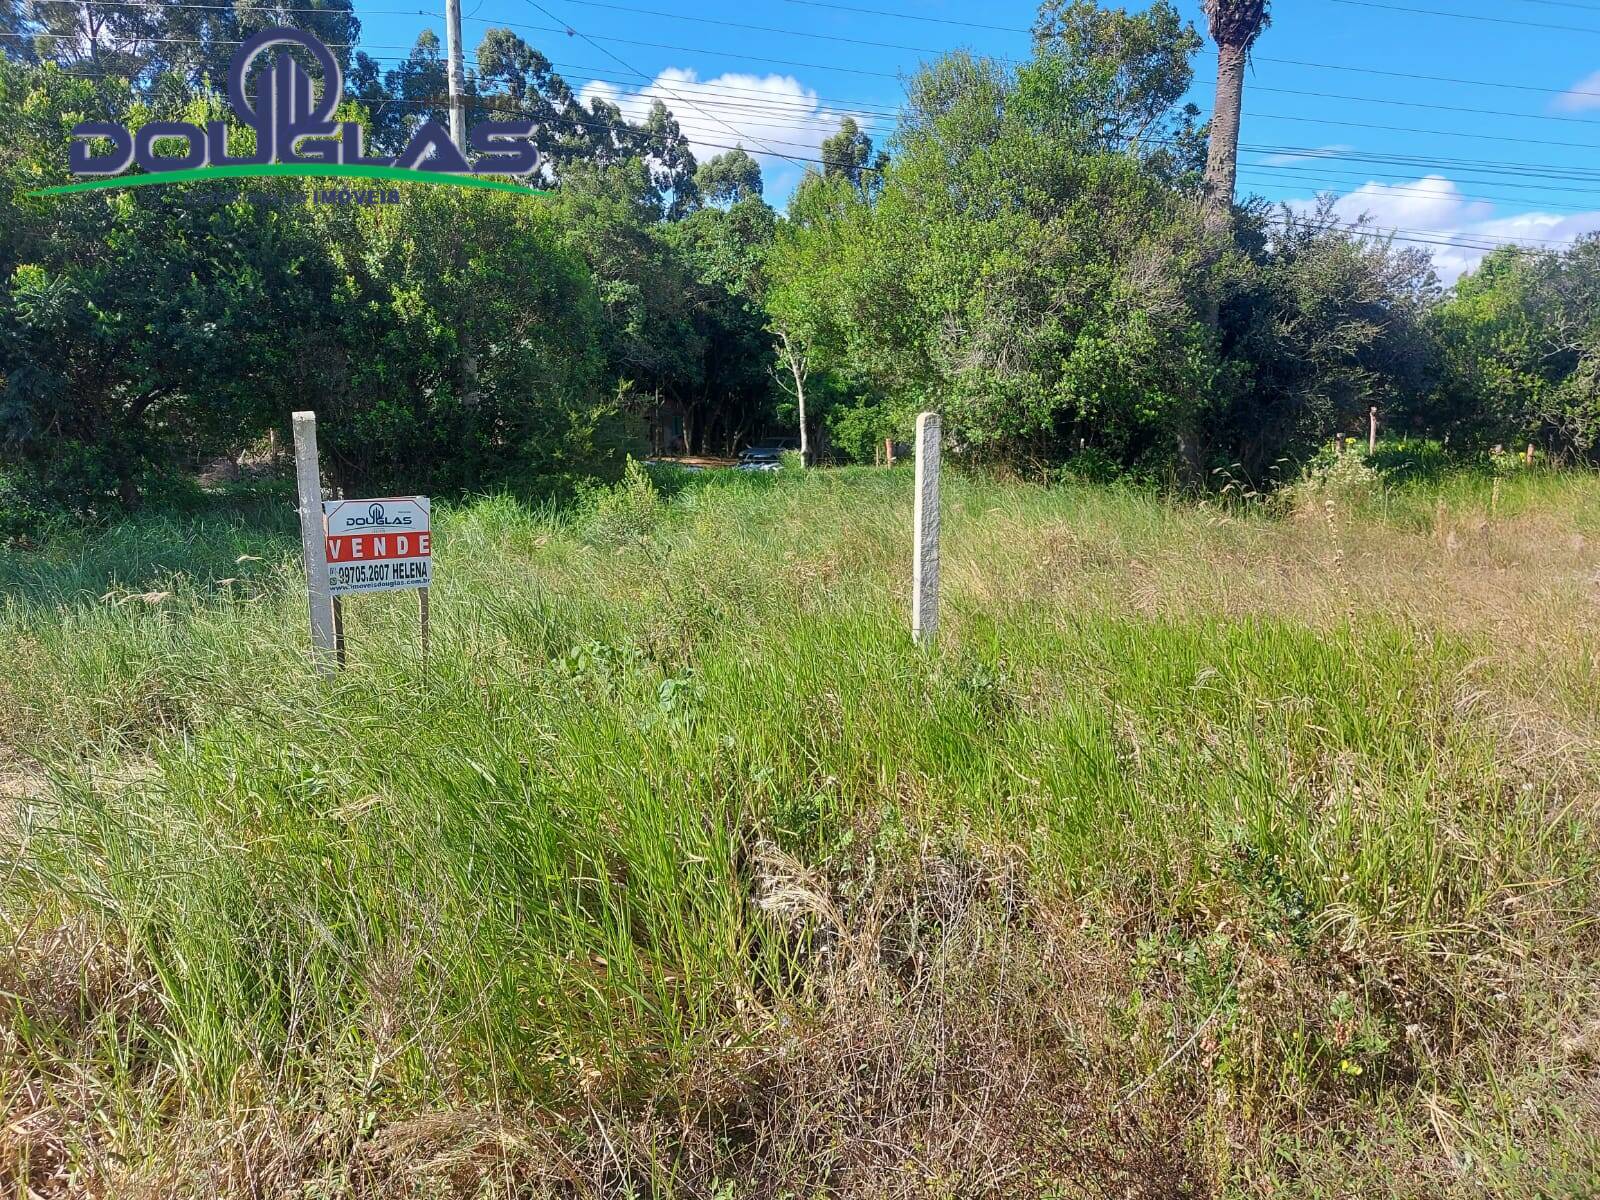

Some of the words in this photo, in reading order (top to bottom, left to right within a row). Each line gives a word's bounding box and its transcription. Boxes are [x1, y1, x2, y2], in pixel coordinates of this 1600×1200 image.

[346, 516, 413, 526] DOUGLAS
[329, 534, 430, 560] VENDE
[392, 561, 428, 580] HELENA
